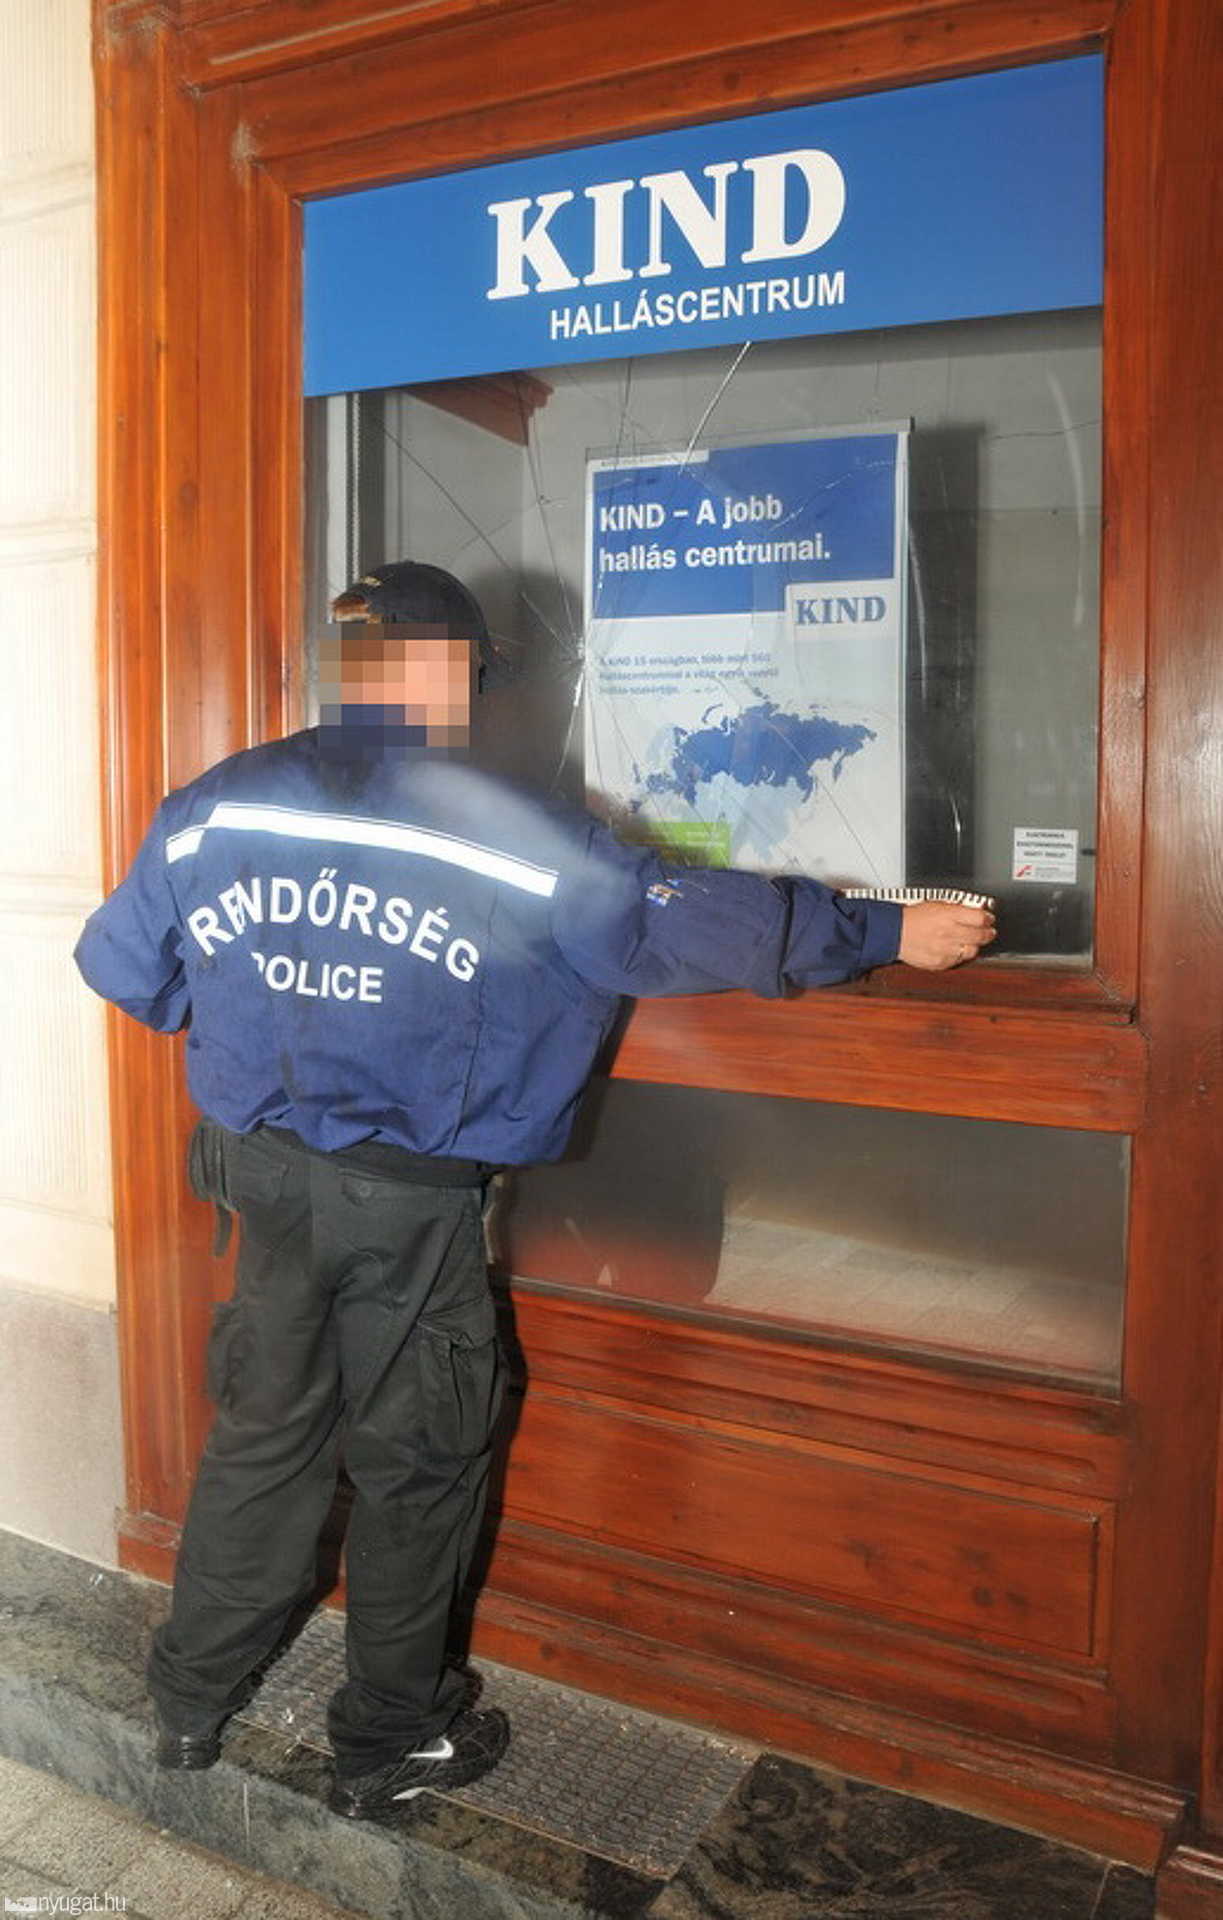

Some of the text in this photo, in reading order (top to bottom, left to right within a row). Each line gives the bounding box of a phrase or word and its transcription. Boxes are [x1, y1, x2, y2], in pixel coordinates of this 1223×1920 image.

[487, 149, 846, 300] KIND
[550, 271, 846, 340] HALLÁSCENTRUM
[600, 504, 665, 532] KIND
[696, 498, 717, 526] A
[722, 494, 783, 529] jobb
[600, 532, 831, 573] hallás centrumai.
[794, 595, 887, 626] KIND
